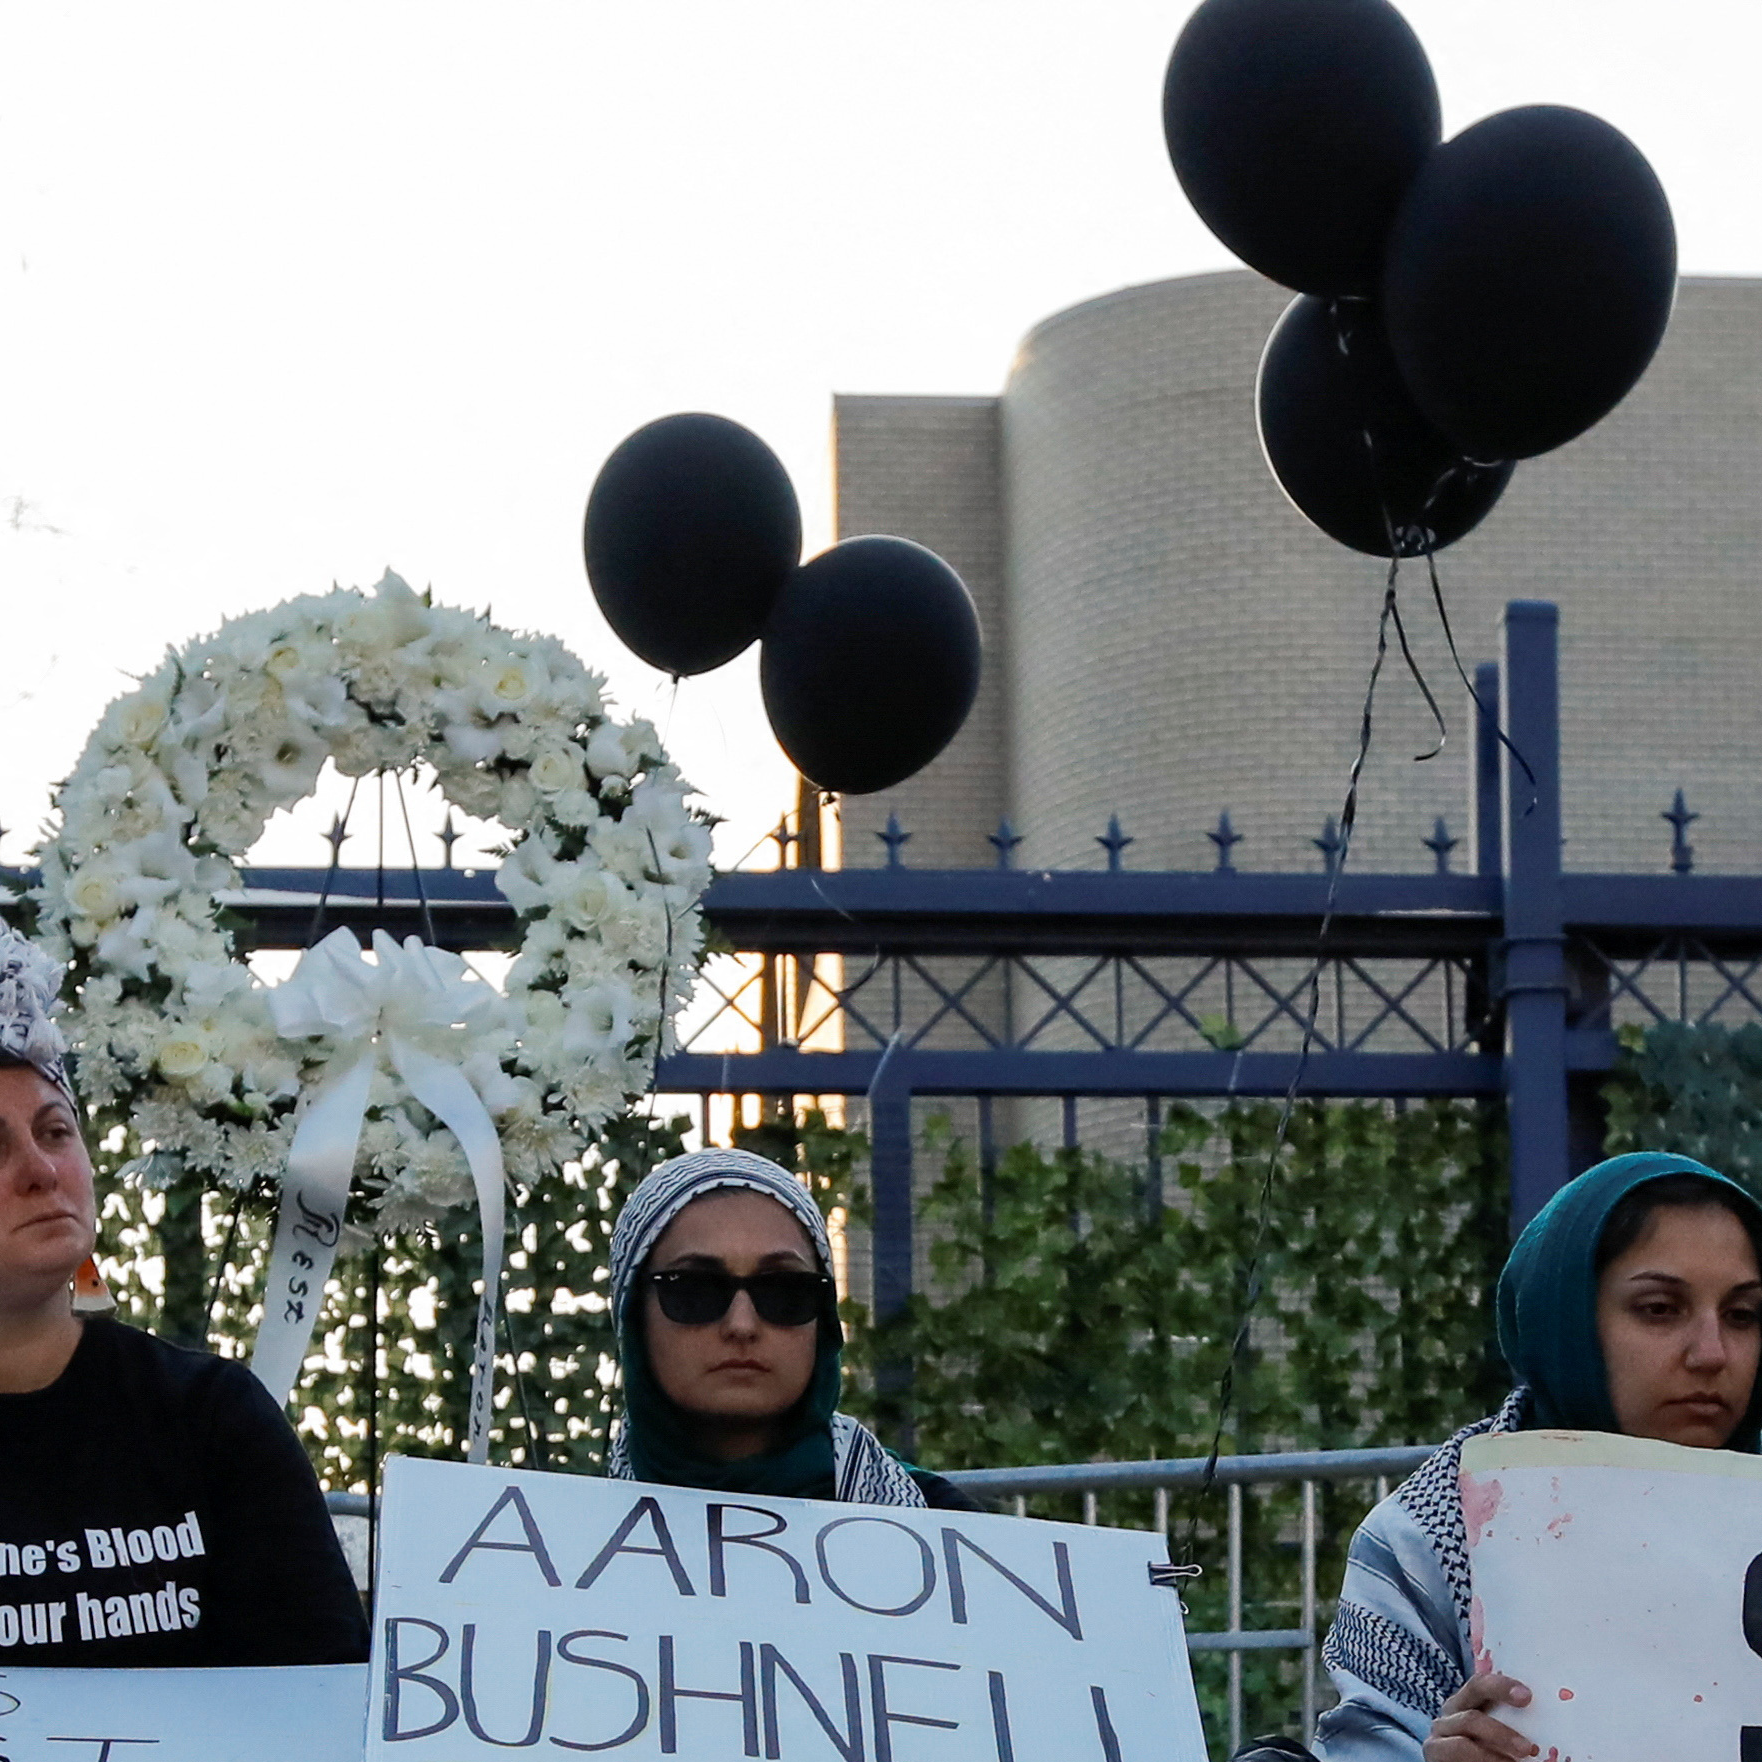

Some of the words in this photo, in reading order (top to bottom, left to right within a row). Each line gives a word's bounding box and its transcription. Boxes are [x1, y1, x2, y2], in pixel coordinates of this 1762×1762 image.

[84, 1511, 206, 1569] Blood
[439, 1486, 1084, 1641] AARON
[76, 1580, 202, 1642] hands
